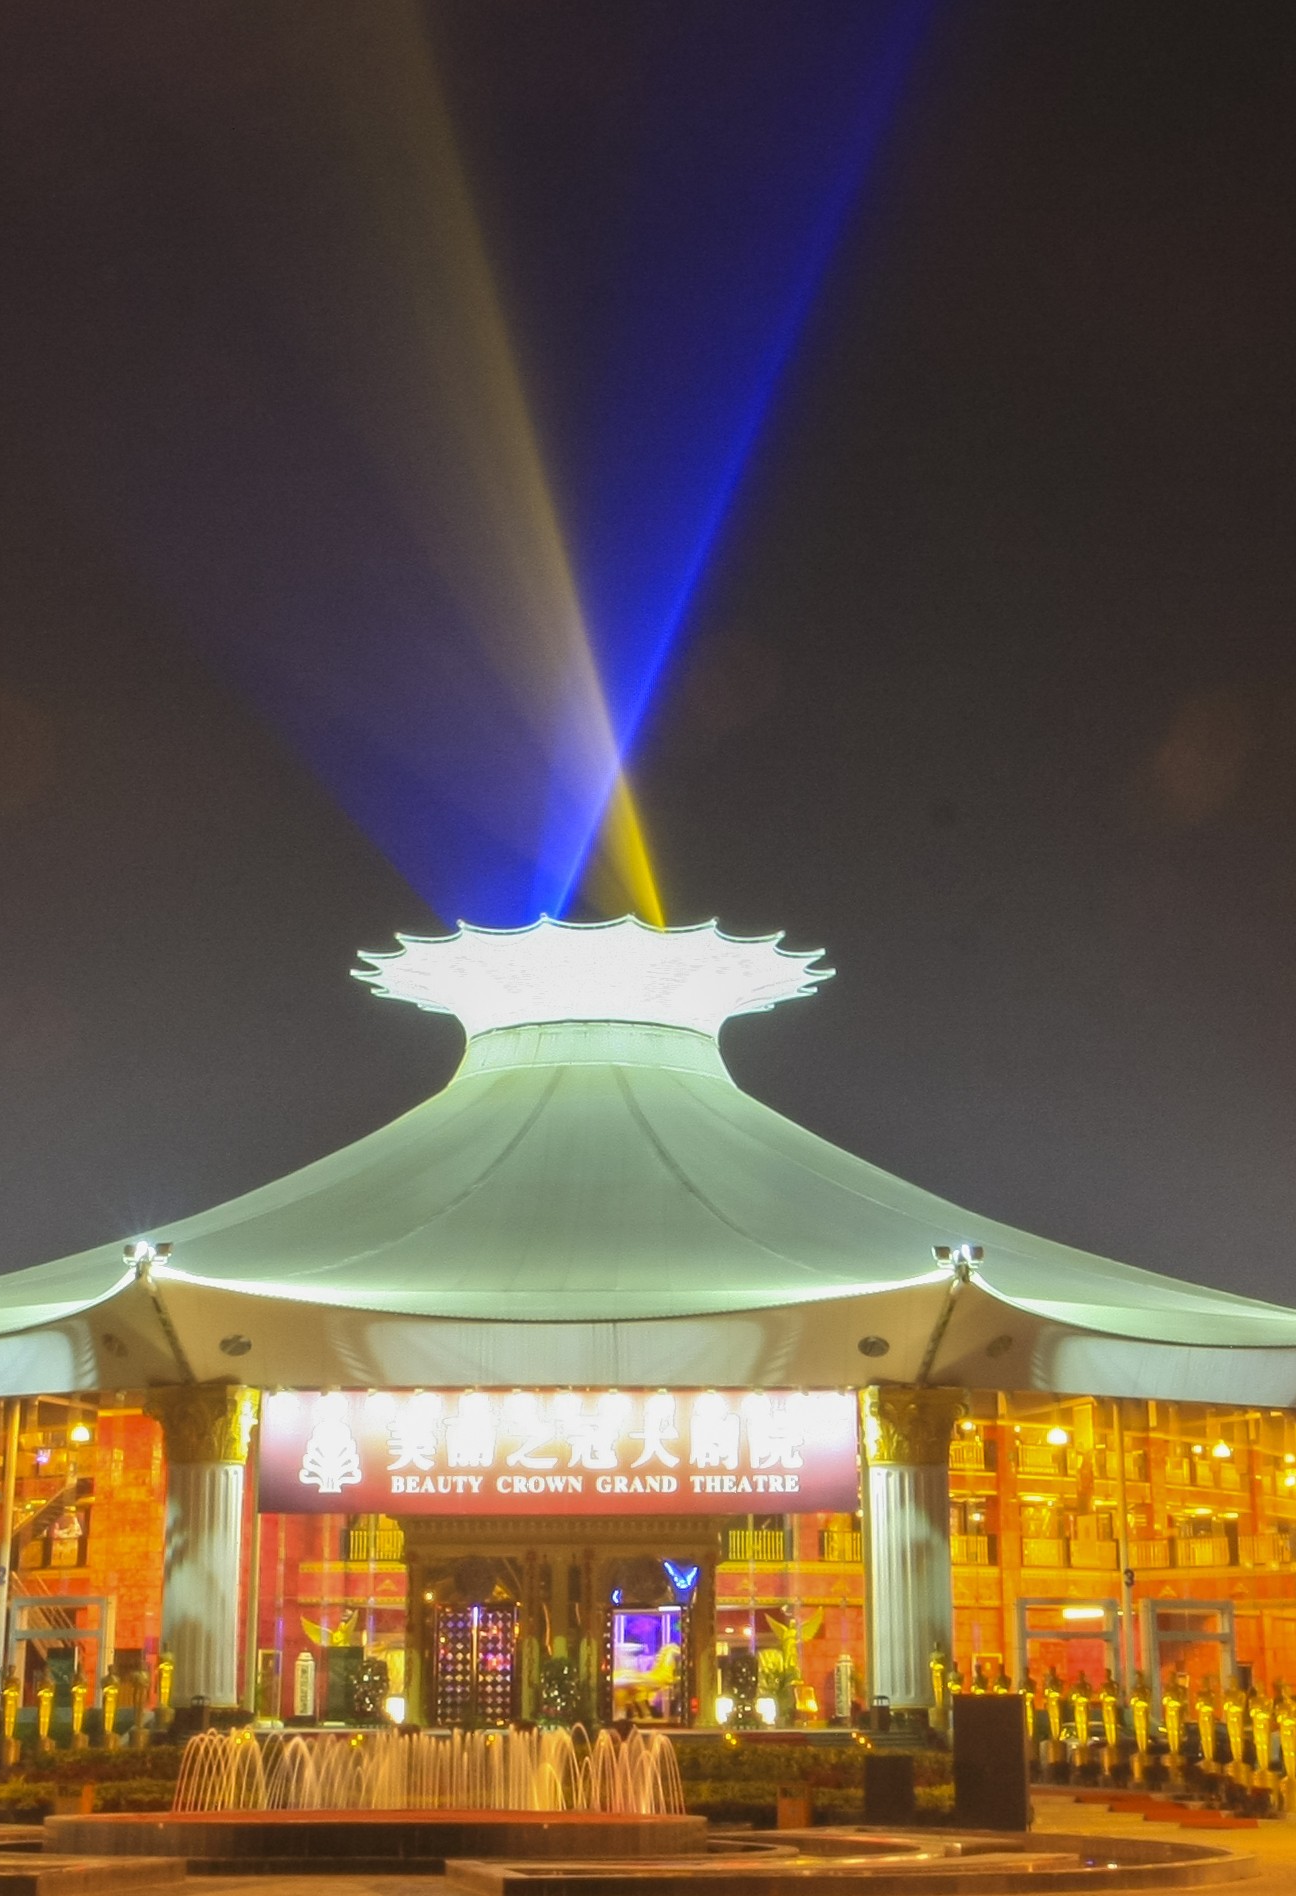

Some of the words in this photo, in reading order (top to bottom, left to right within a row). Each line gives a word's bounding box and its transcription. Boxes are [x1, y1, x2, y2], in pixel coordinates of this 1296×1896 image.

[391, 1475, 483, 1494] BEAUTY
[496, 1475, 583, 1494] CROWN
[596, 1475, 678, 1494] GRAND
[689, 1475, 800, 1494] THEATRE
